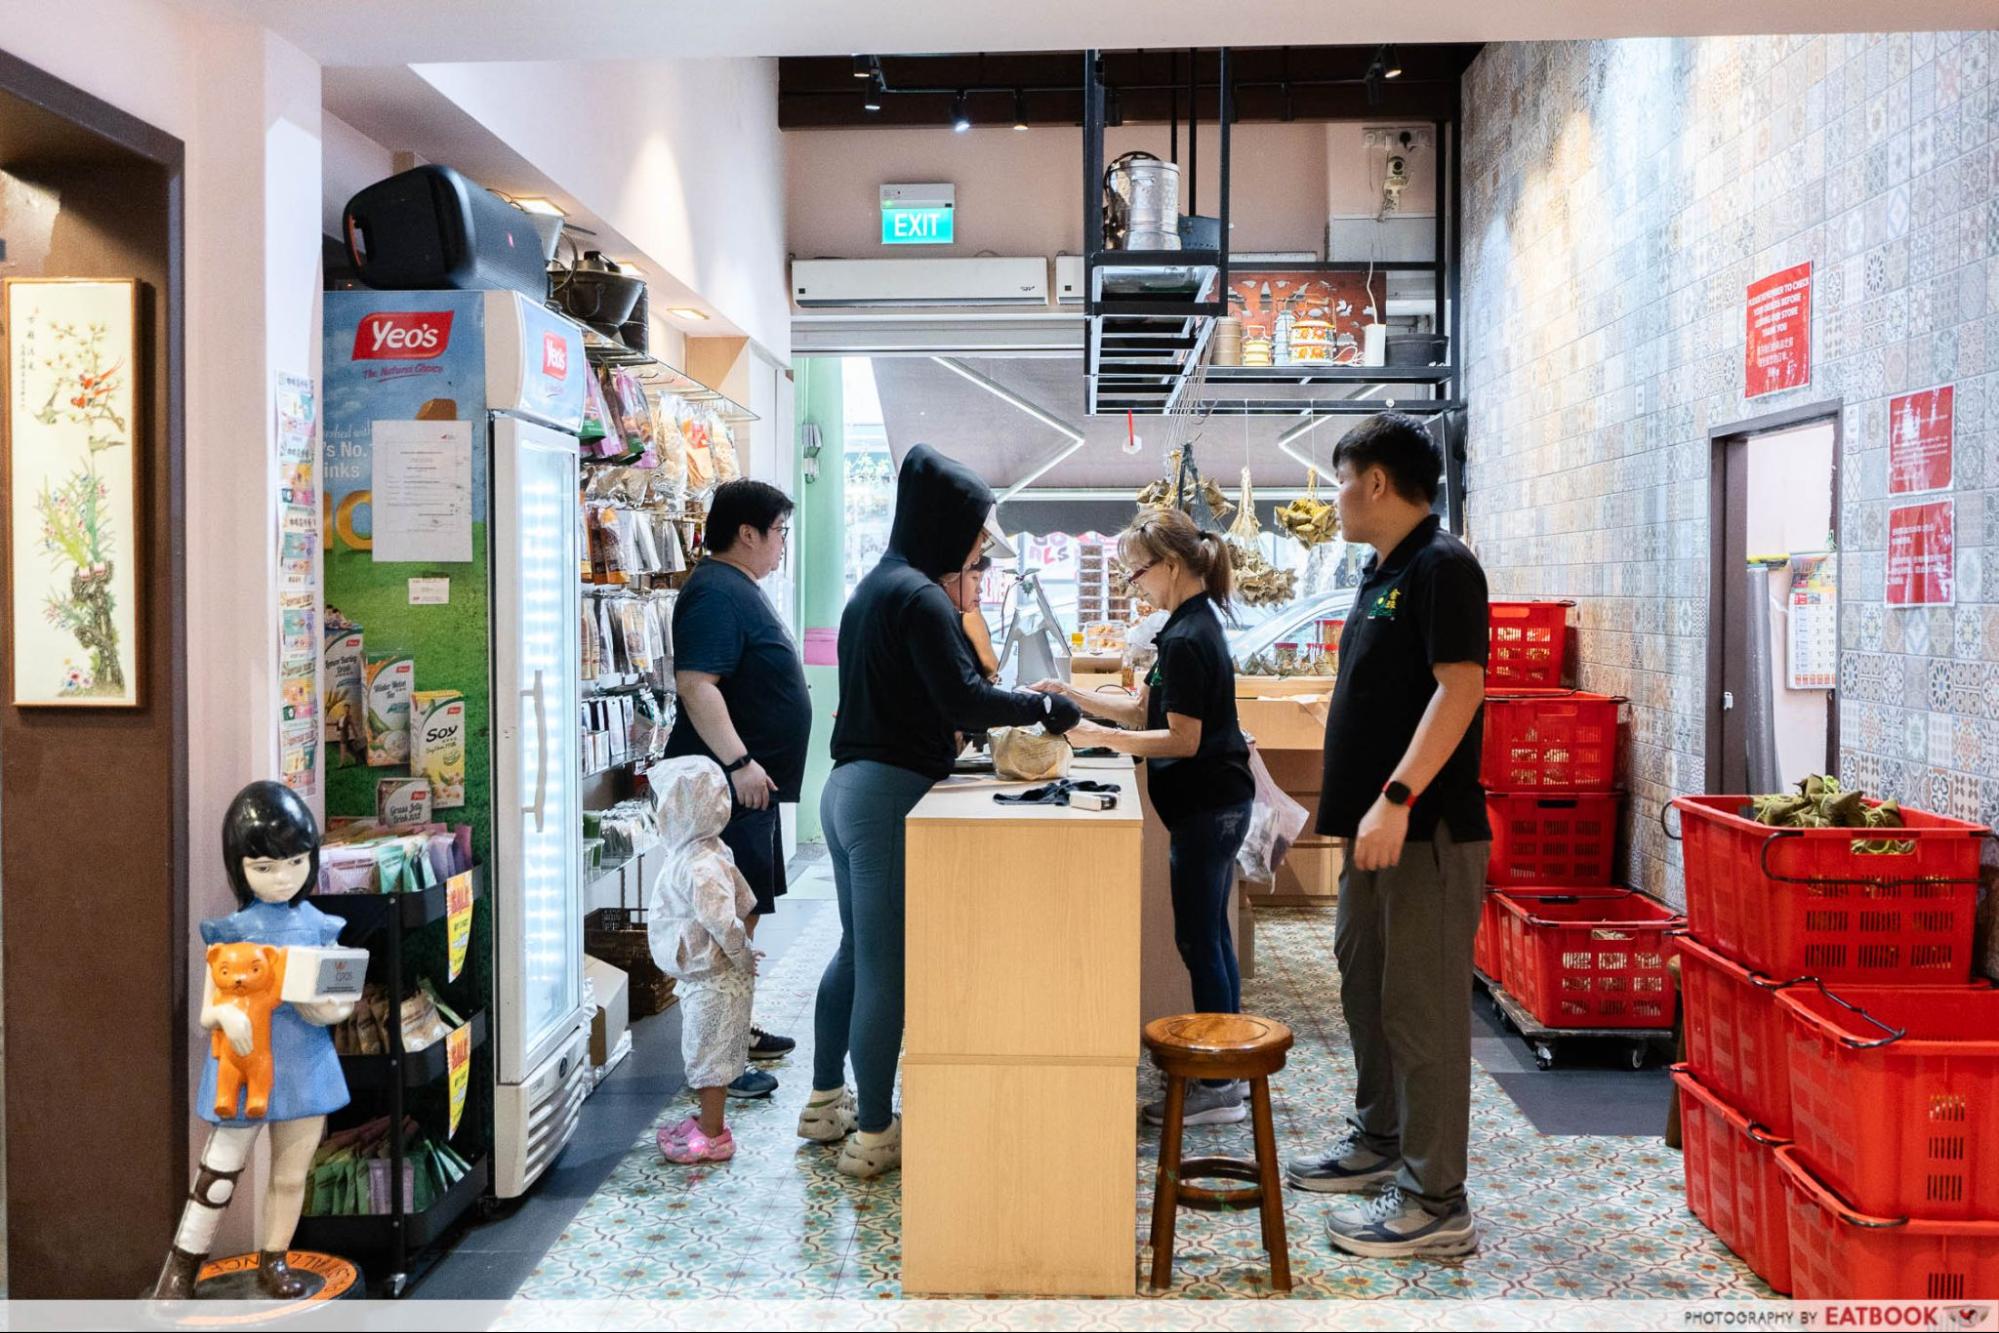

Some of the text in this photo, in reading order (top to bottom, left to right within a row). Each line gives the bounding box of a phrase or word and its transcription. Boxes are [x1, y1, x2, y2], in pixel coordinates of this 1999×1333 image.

[894, 214, 940, 237] EXIT
[372, 320, 439, 351] Yeo's
[340, 441, 368, 457] No.
